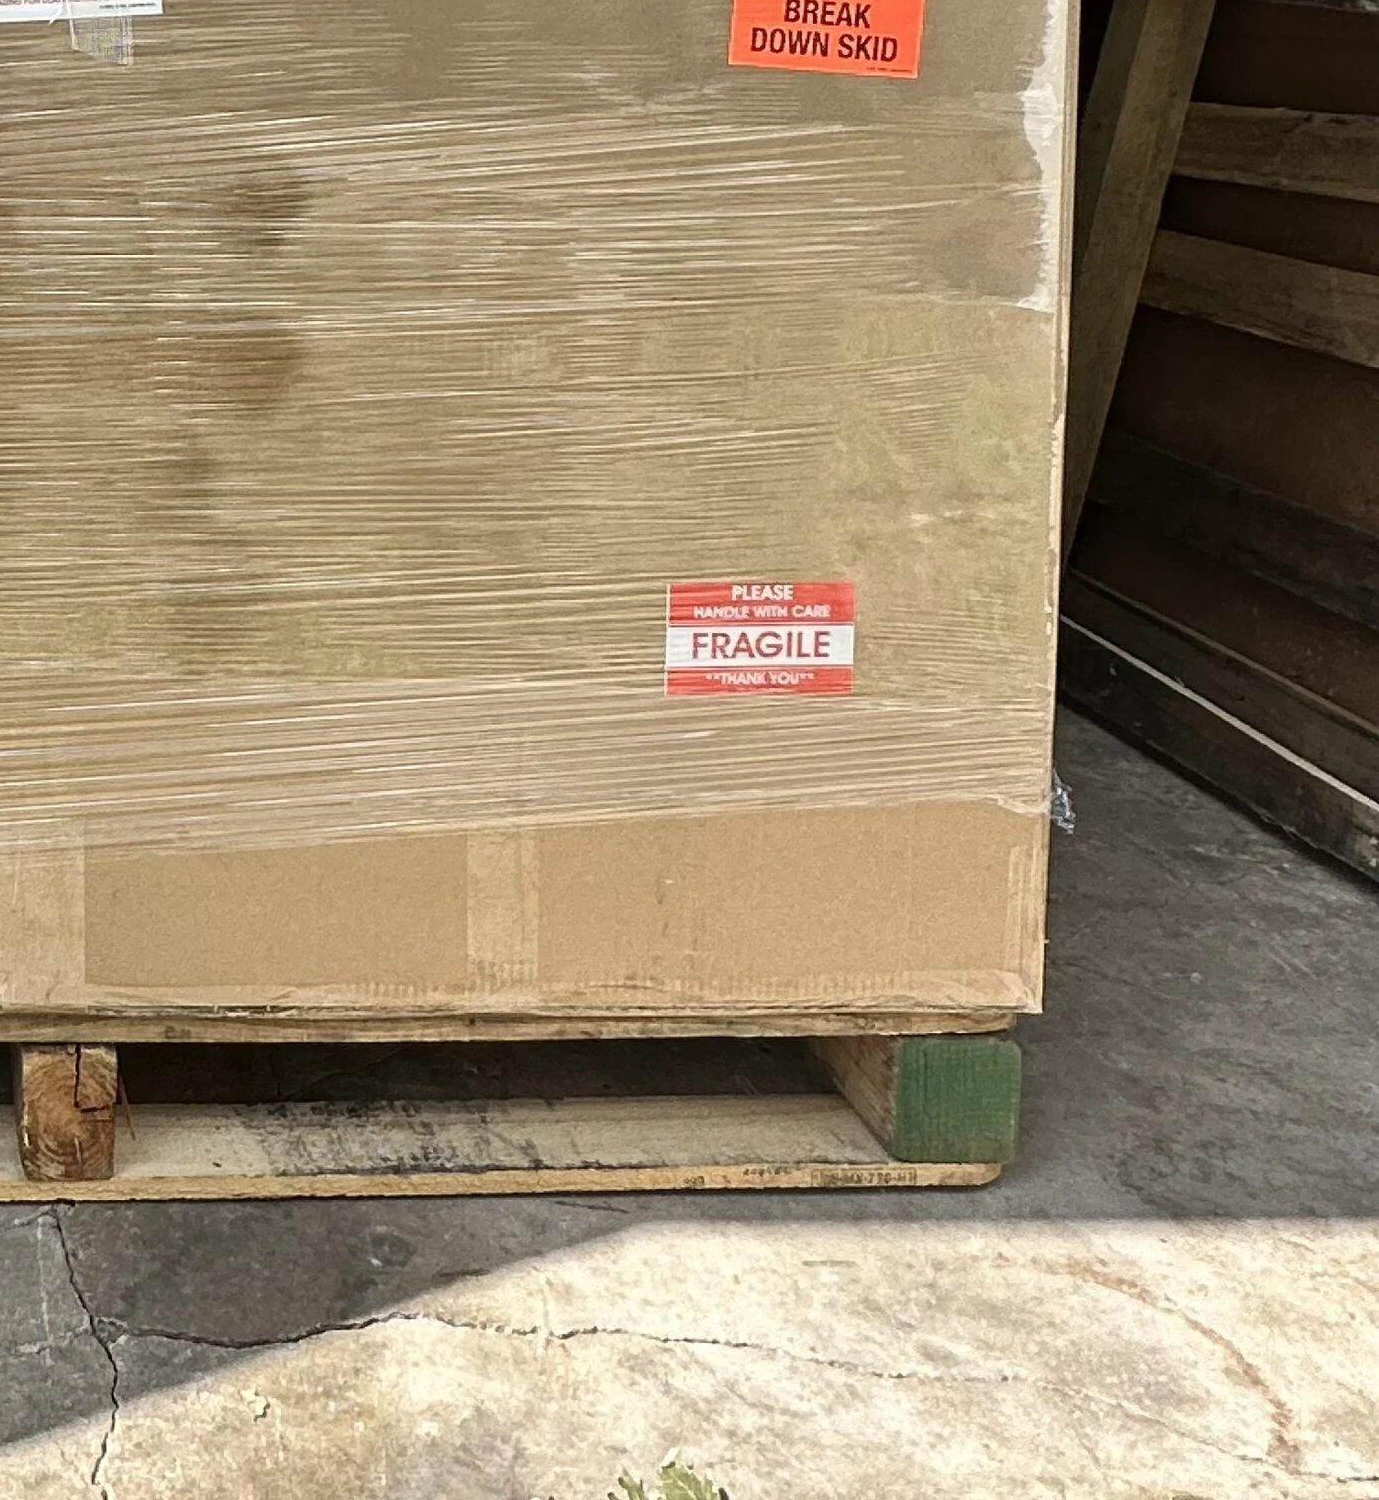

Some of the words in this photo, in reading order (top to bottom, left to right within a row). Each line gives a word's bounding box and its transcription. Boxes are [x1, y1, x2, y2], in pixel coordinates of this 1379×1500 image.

[750, 27, 830, 57] DOWN
[838, 34, 898, 62] SKID
[731, 585, 794, 601] PLEASE
[693, 605, 750, 619] HANDLE
[753, 605, 788, 618] WITH
[792, 604, 831, 618] CARE
[691, 631, 831, 660] FRAGILE
